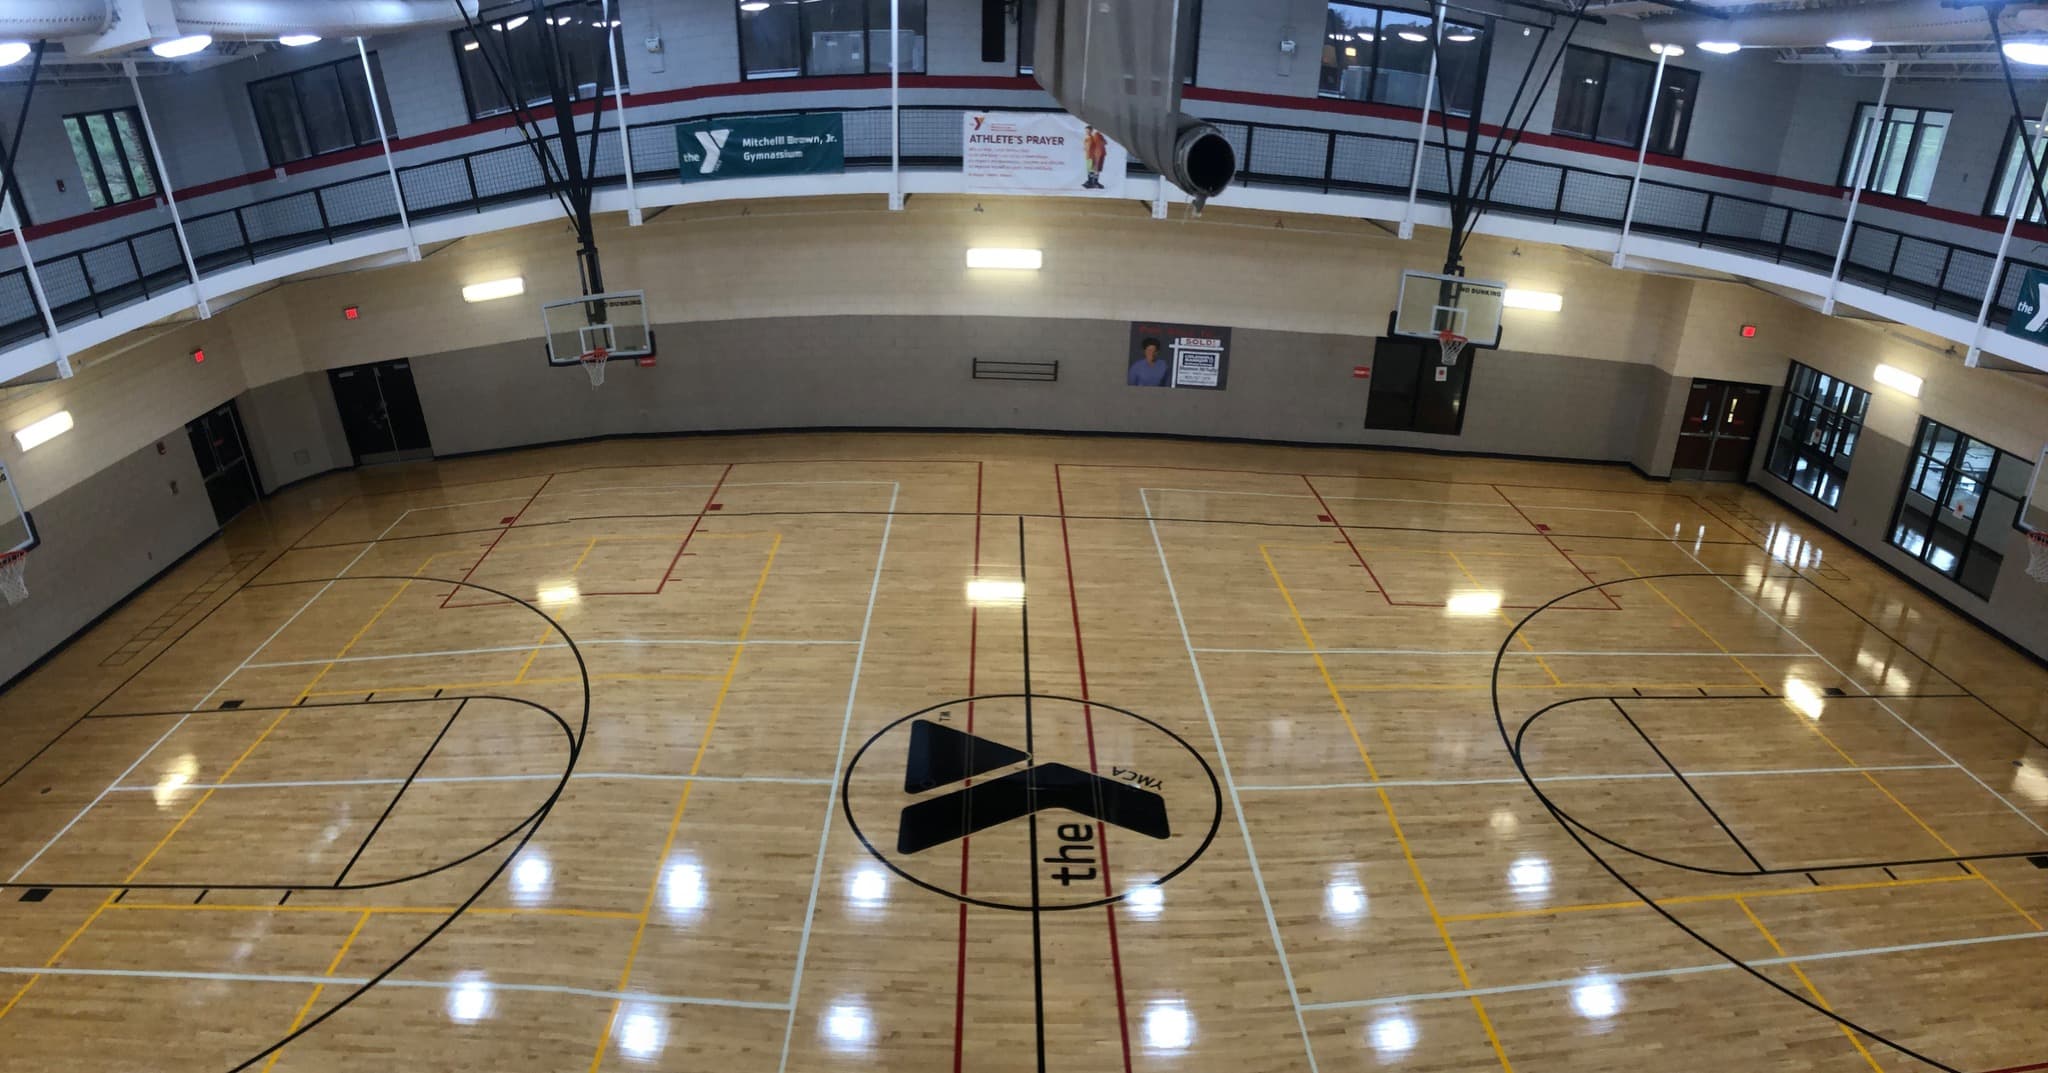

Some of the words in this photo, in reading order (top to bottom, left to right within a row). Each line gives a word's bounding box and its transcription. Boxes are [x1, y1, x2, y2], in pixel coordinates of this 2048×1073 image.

[825, 133, 838, 143] Jr.
[969, 134, 1024, 144] ATHLETE'S
[1026, 135, 1065, 145] PRAYER
[683, 152, 700, 162] the
[2017, 301, 2034, 315] the
[1112, 765, 1163, 791] YMCA
[1043, 823, 1097, 887] the
